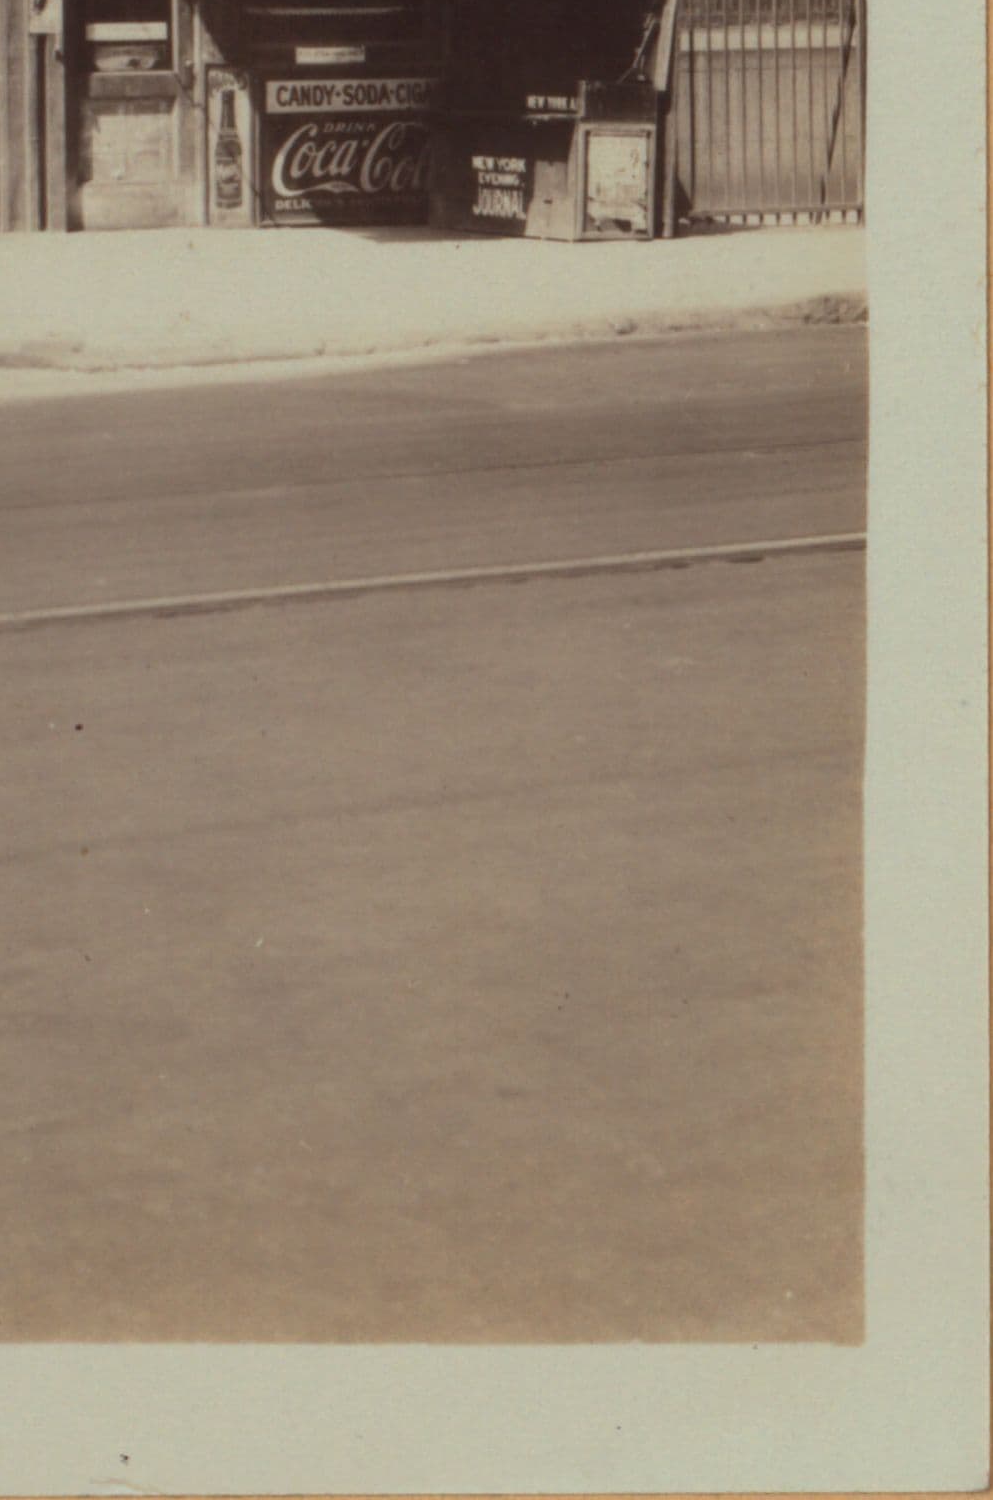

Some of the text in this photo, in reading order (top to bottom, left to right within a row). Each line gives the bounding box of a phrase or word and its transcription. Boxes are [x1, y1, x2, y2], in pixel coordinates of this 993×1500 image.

[472, 155, 527, 173] NEW YORK
[478, 171, 521, 187] EVENING
[472, 186, 527, 220] JOURNAL
